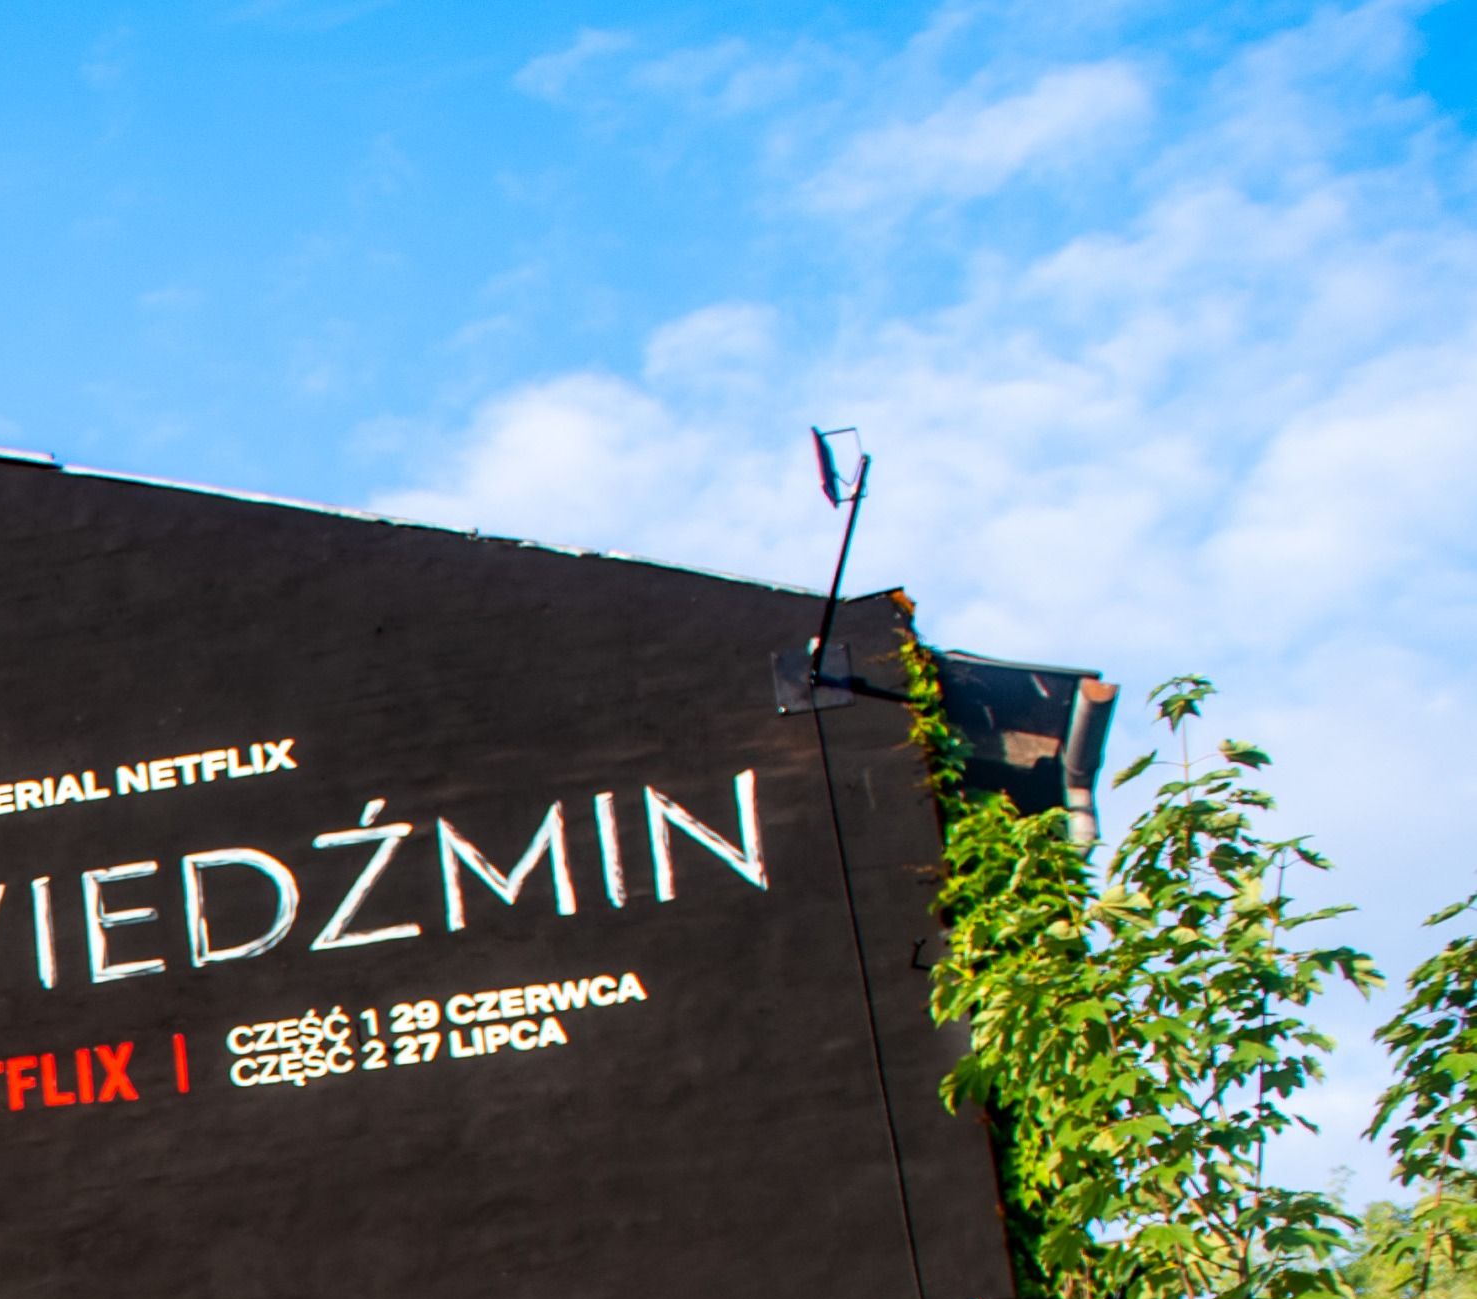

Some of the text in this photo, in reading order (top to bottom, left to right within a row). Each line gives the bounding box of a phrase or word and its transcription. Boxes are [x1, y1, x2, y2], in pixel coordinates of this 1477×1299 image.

[116, 738, 298, 796] NETFLIX
[226, 972, 648, 1053] CZĘŚĆ 1 29 CZERWCA
[229, 1016, 568, 1087] CZĘŚĆ 2 27 LIPCA
